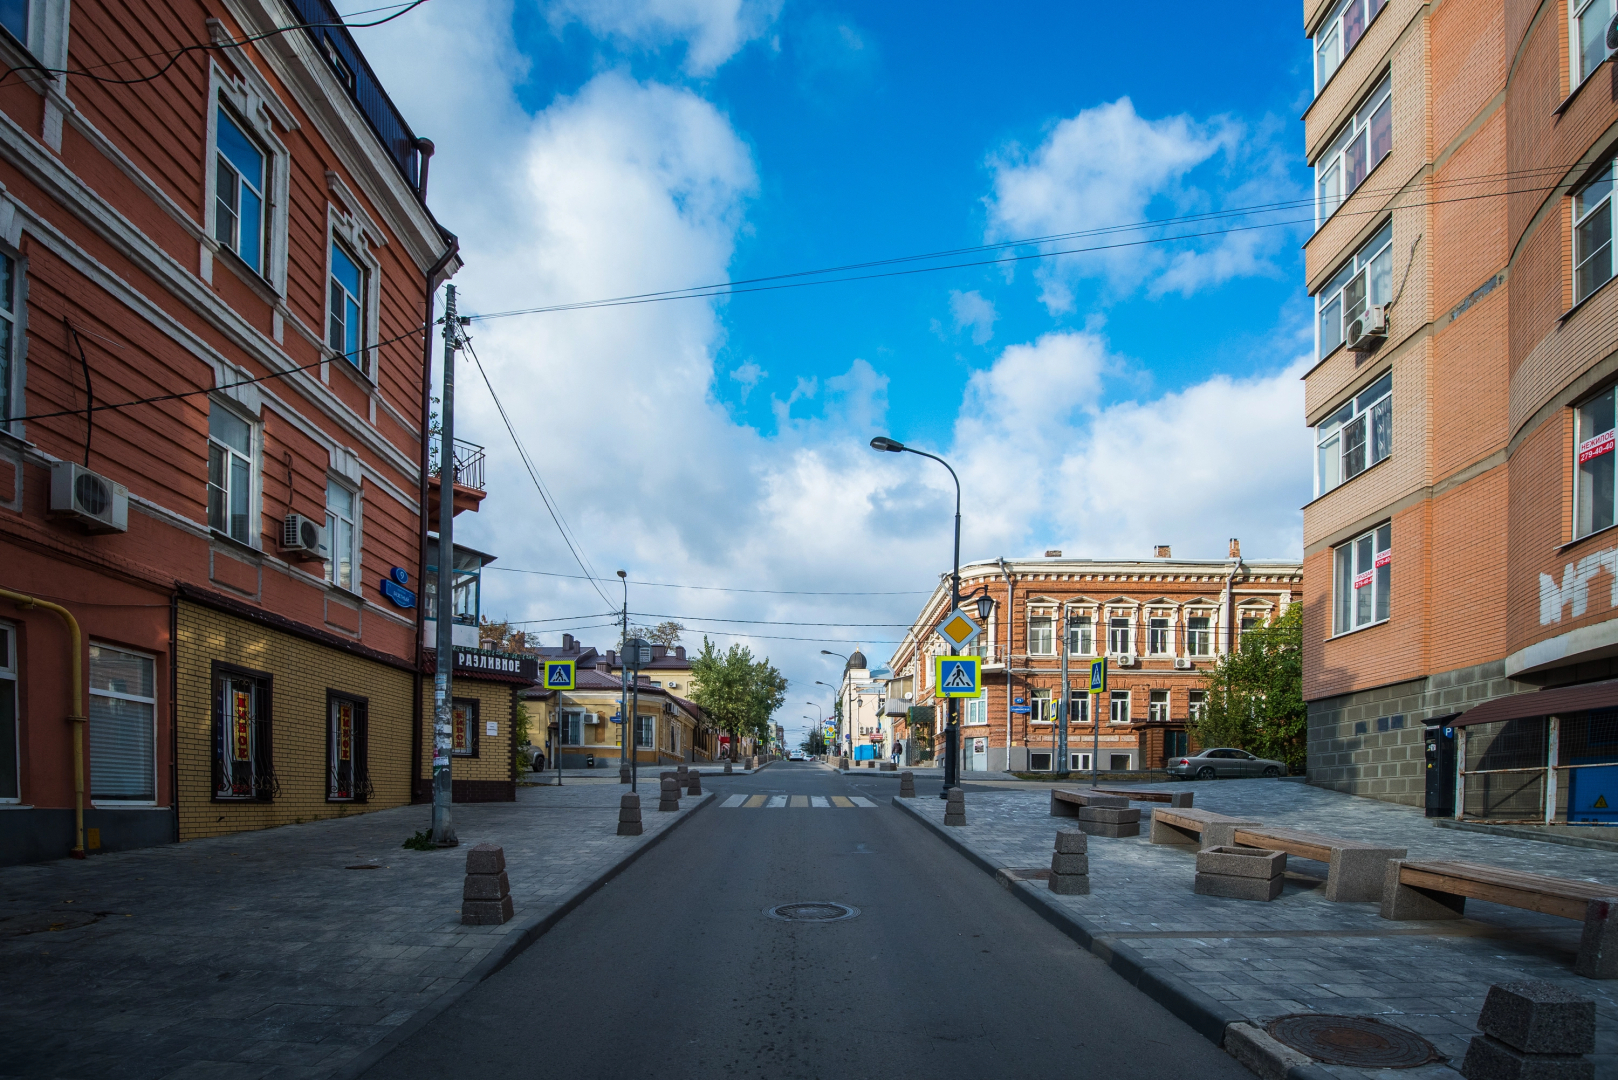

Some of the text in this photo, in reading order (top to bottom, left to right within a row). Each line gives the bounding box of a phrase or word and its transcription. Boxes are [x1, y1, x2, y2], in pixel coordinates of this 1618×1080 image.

[1581, 430, 1615, 451] НЕЖИЛОЕ
[1580, 441, 1614, 462] 279-40-40
[400, 571, 405, 580] 9
[458, 652, 521, 673] РАЗЛИВНОЕ
[1445, 727, 1452, 737] P
